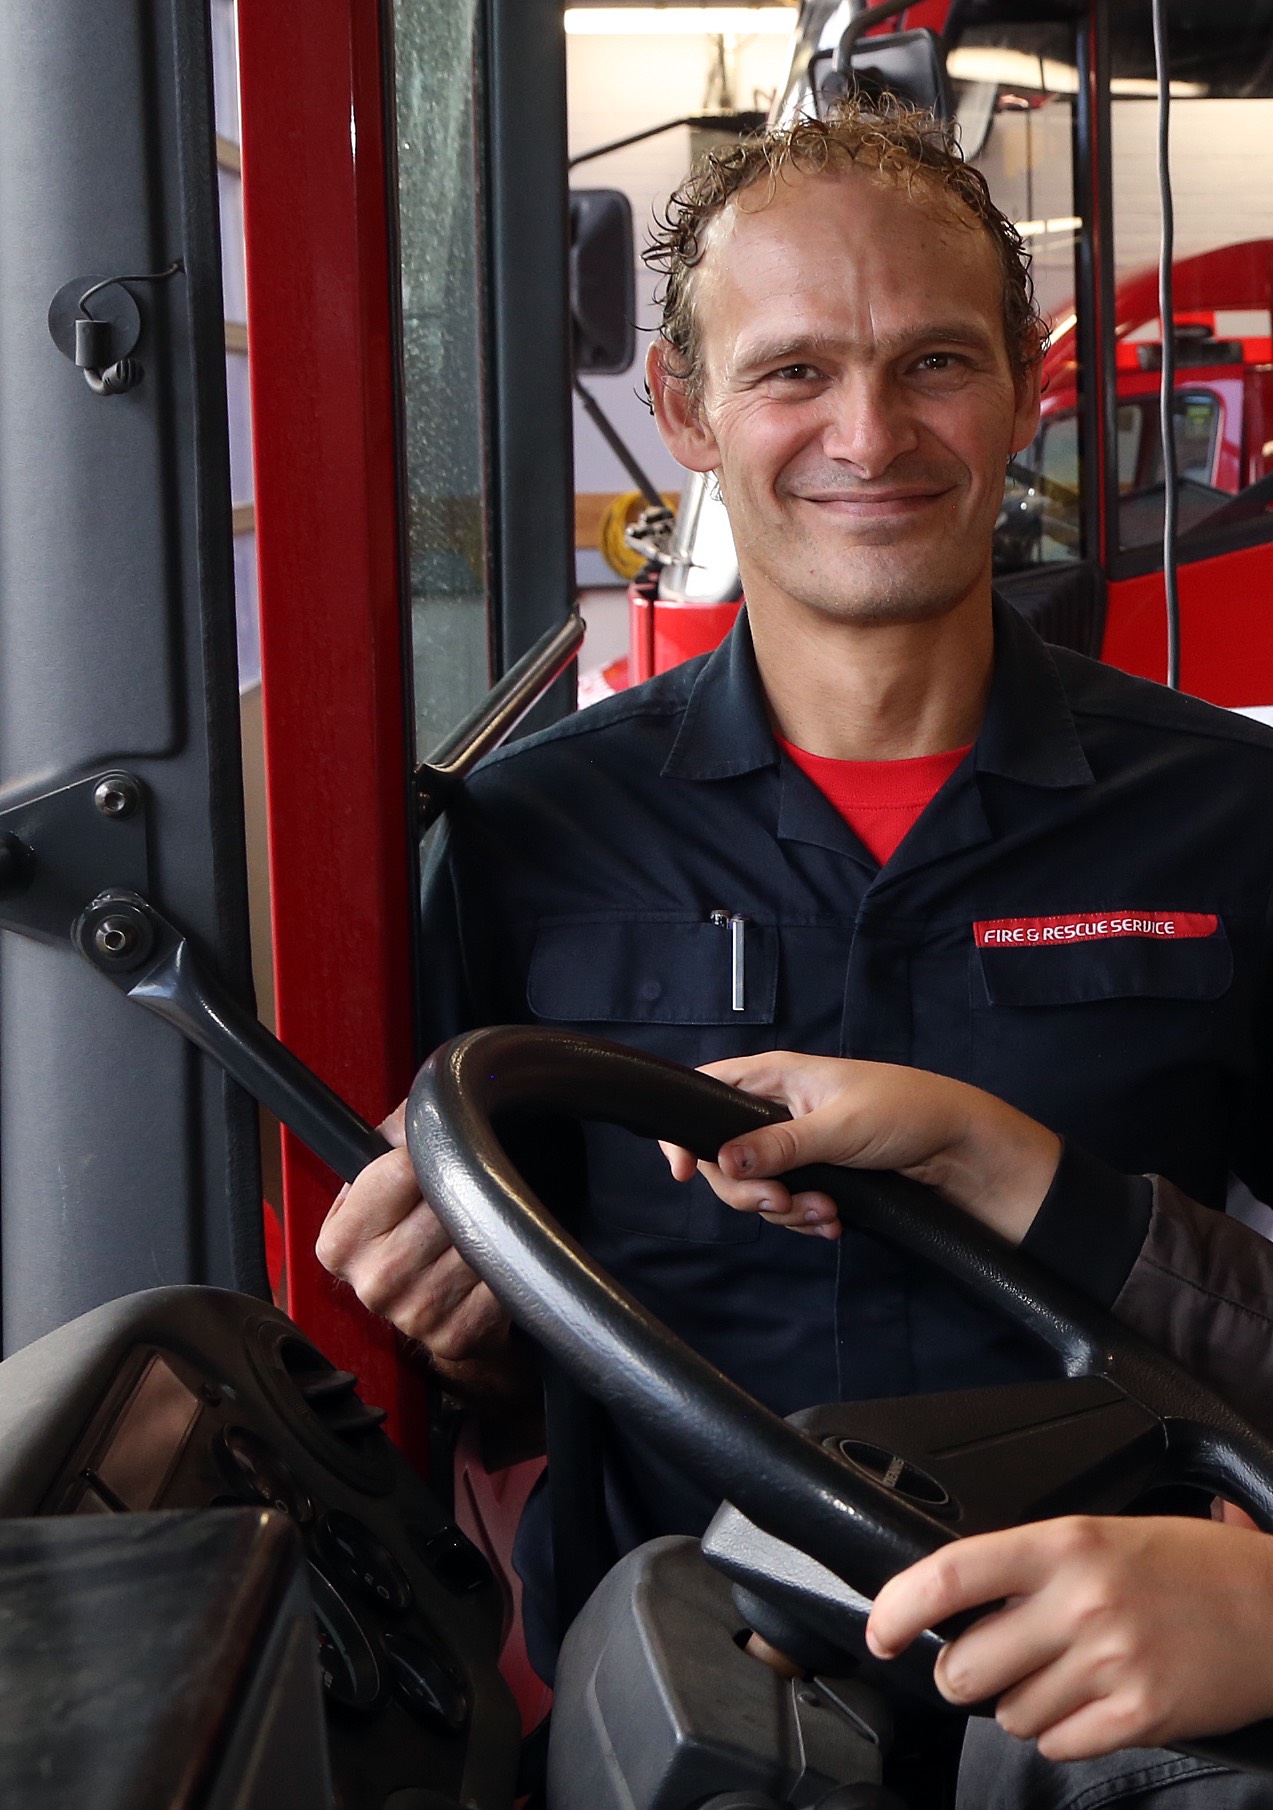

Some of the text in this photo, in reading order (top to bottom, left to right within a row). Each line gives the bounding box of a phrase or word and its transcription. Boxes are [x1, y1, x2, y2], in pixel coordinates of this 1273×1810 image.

[984, 918, 1175, 943] FIRE & RESCUE SERVICE
